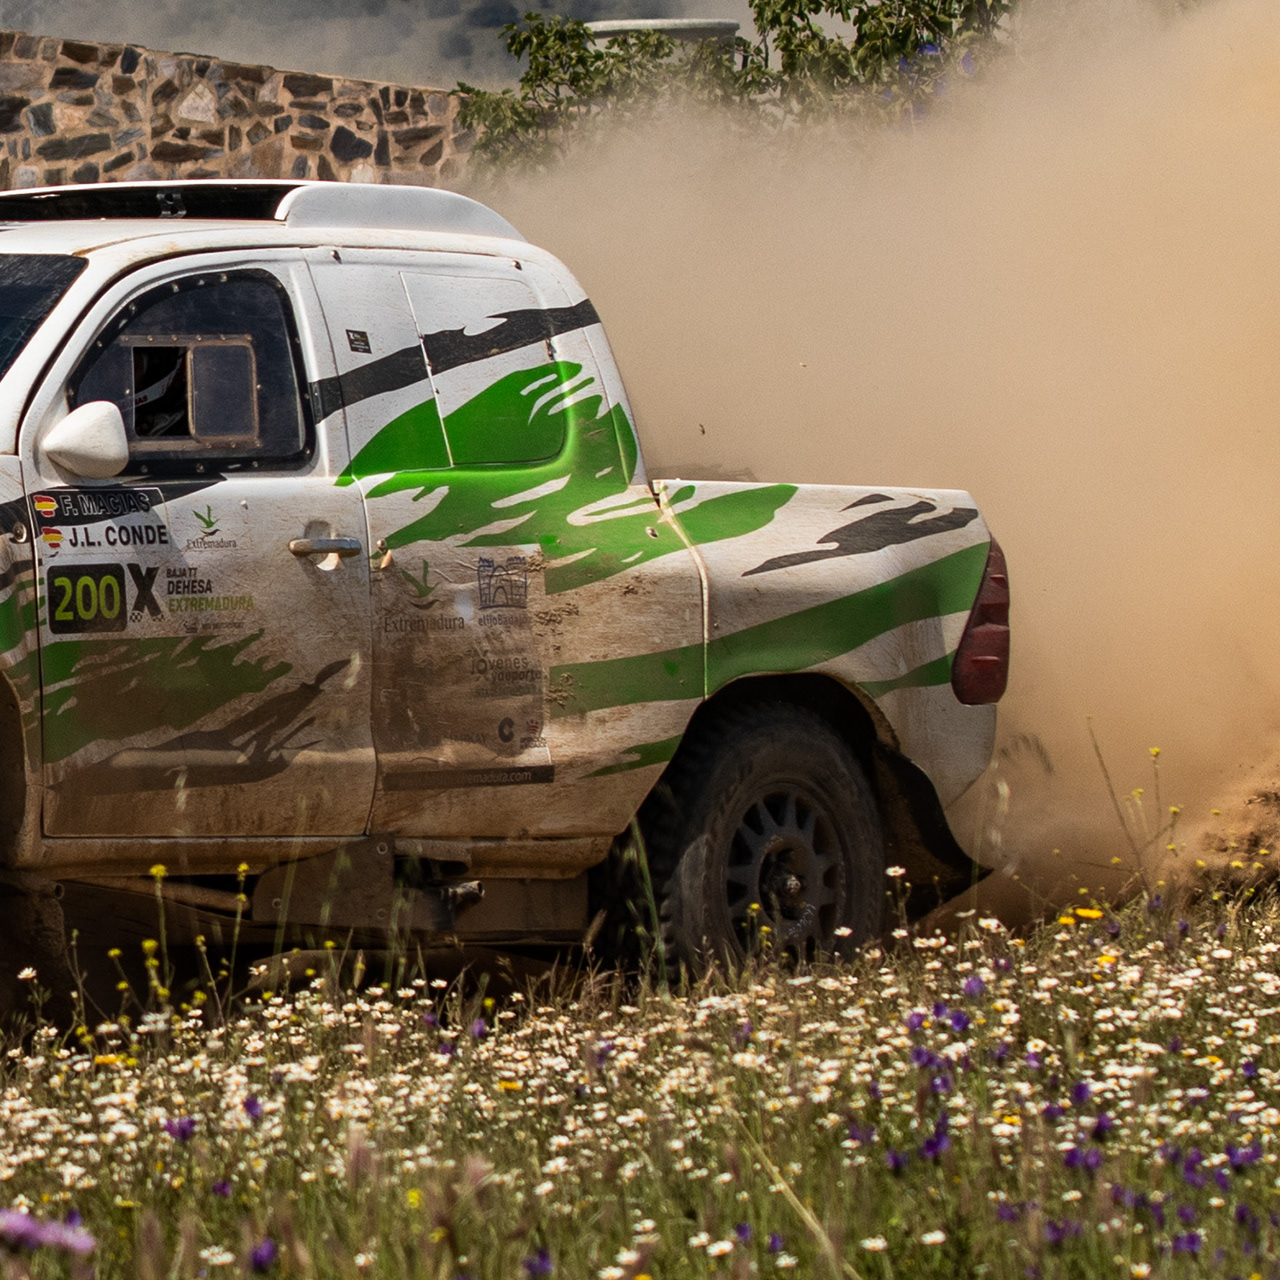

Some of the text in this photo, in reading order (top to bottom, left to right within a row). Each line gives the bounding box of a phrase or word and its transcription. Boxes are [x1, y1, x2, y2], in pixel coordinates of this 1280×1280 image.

[59, 495, 79, 516] F.
[69, 525, 168, 547] J.L. CONDE
[186, 538, 237, 549] Extremadura
[166, 567, 198, 578] BAJA TT
[167, 580, 212, 594] DEHESA
[53, 575, 120, 621] 200
[168, 595, 255, 613] EXTREMADURA
[384, 614, 465, 632] Extremadura
